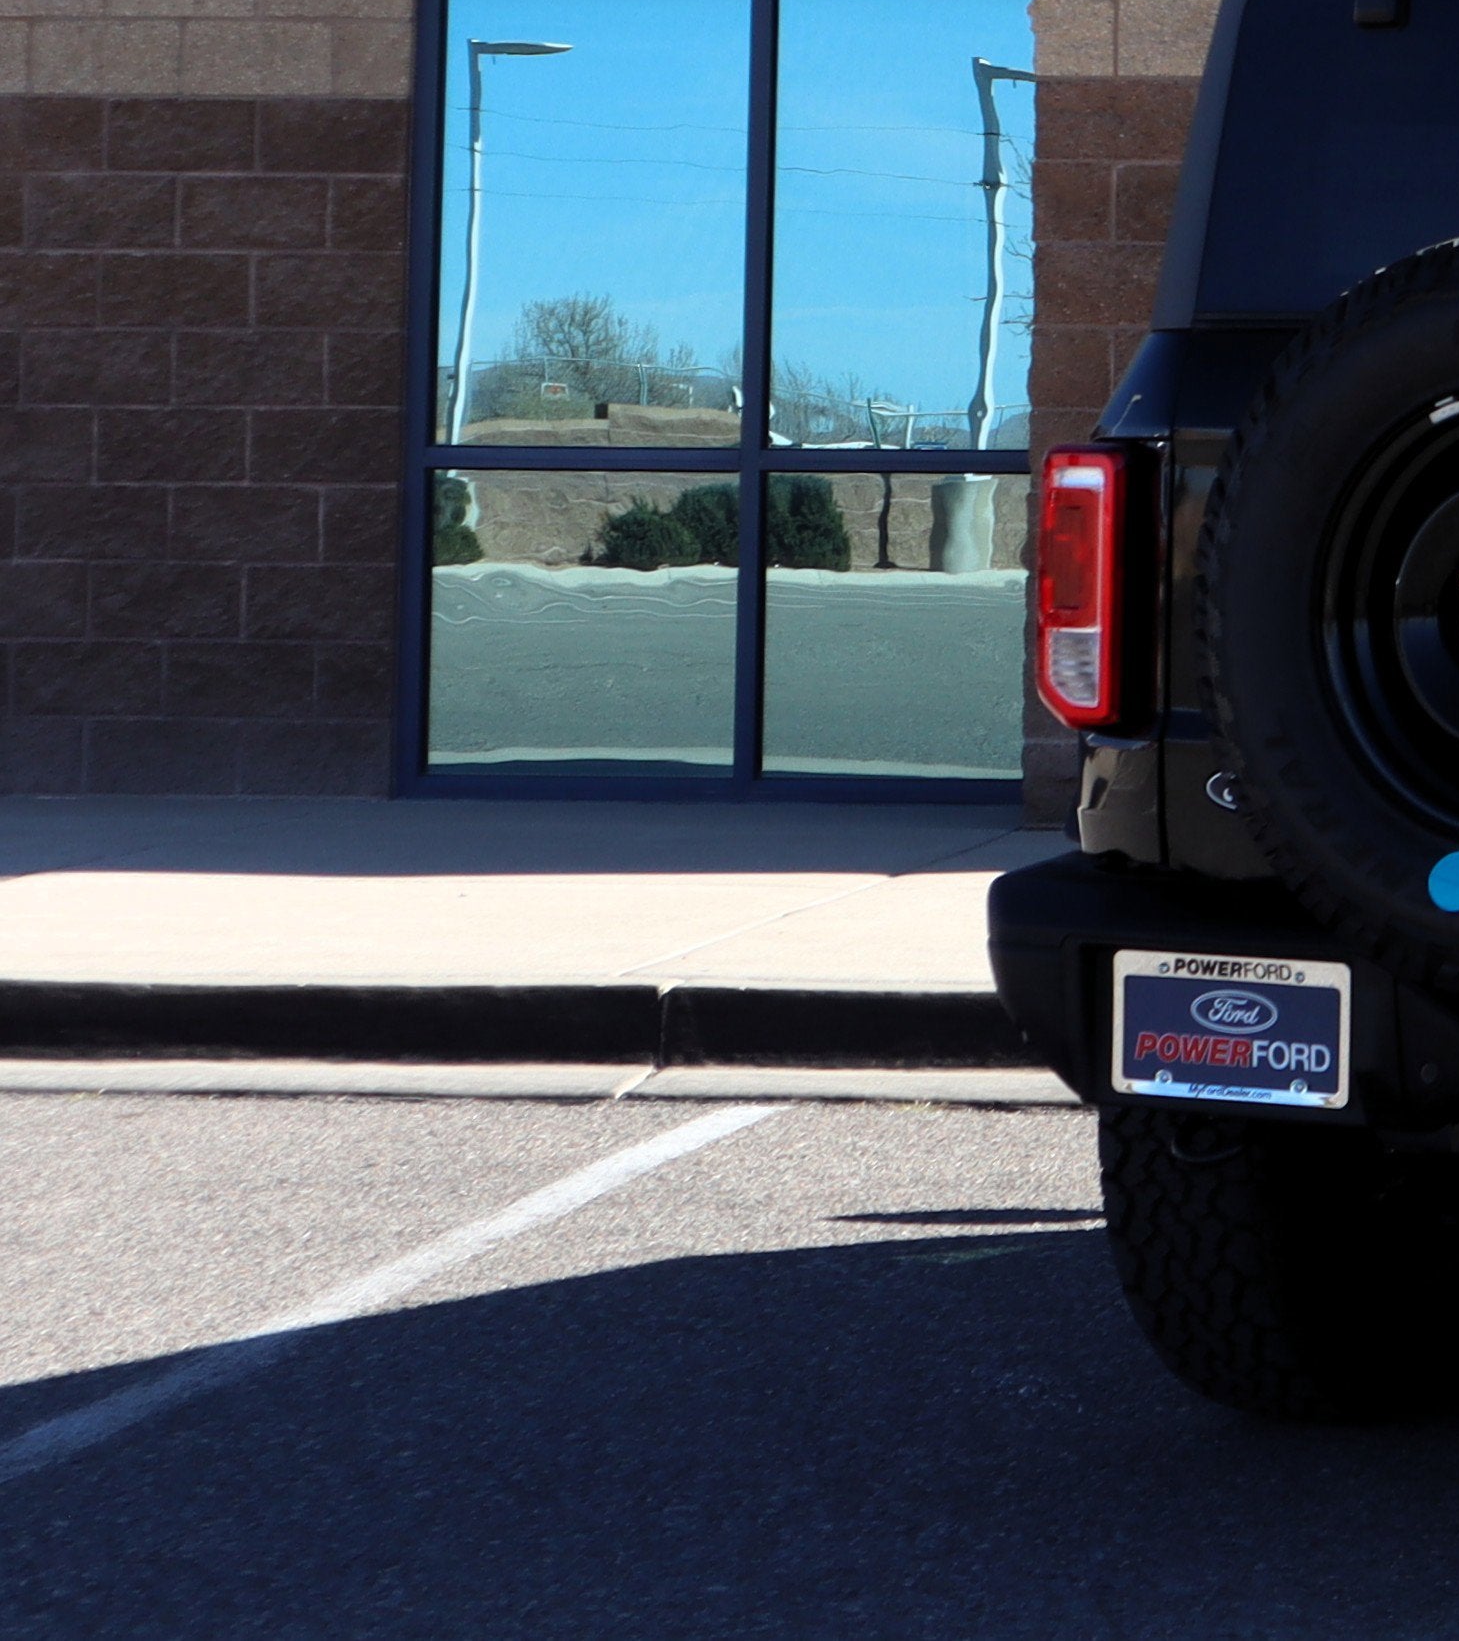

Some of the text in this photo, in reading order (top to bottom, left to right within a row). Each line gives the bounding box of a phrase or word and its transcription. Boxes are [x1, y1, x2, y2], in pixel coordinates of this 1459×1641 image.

[1173, 958, 1293, 982] POWERFORD
[1207, 997, 1261, 1025] Ford
[1134, 1031, 1331, 1073] POWERFORD
